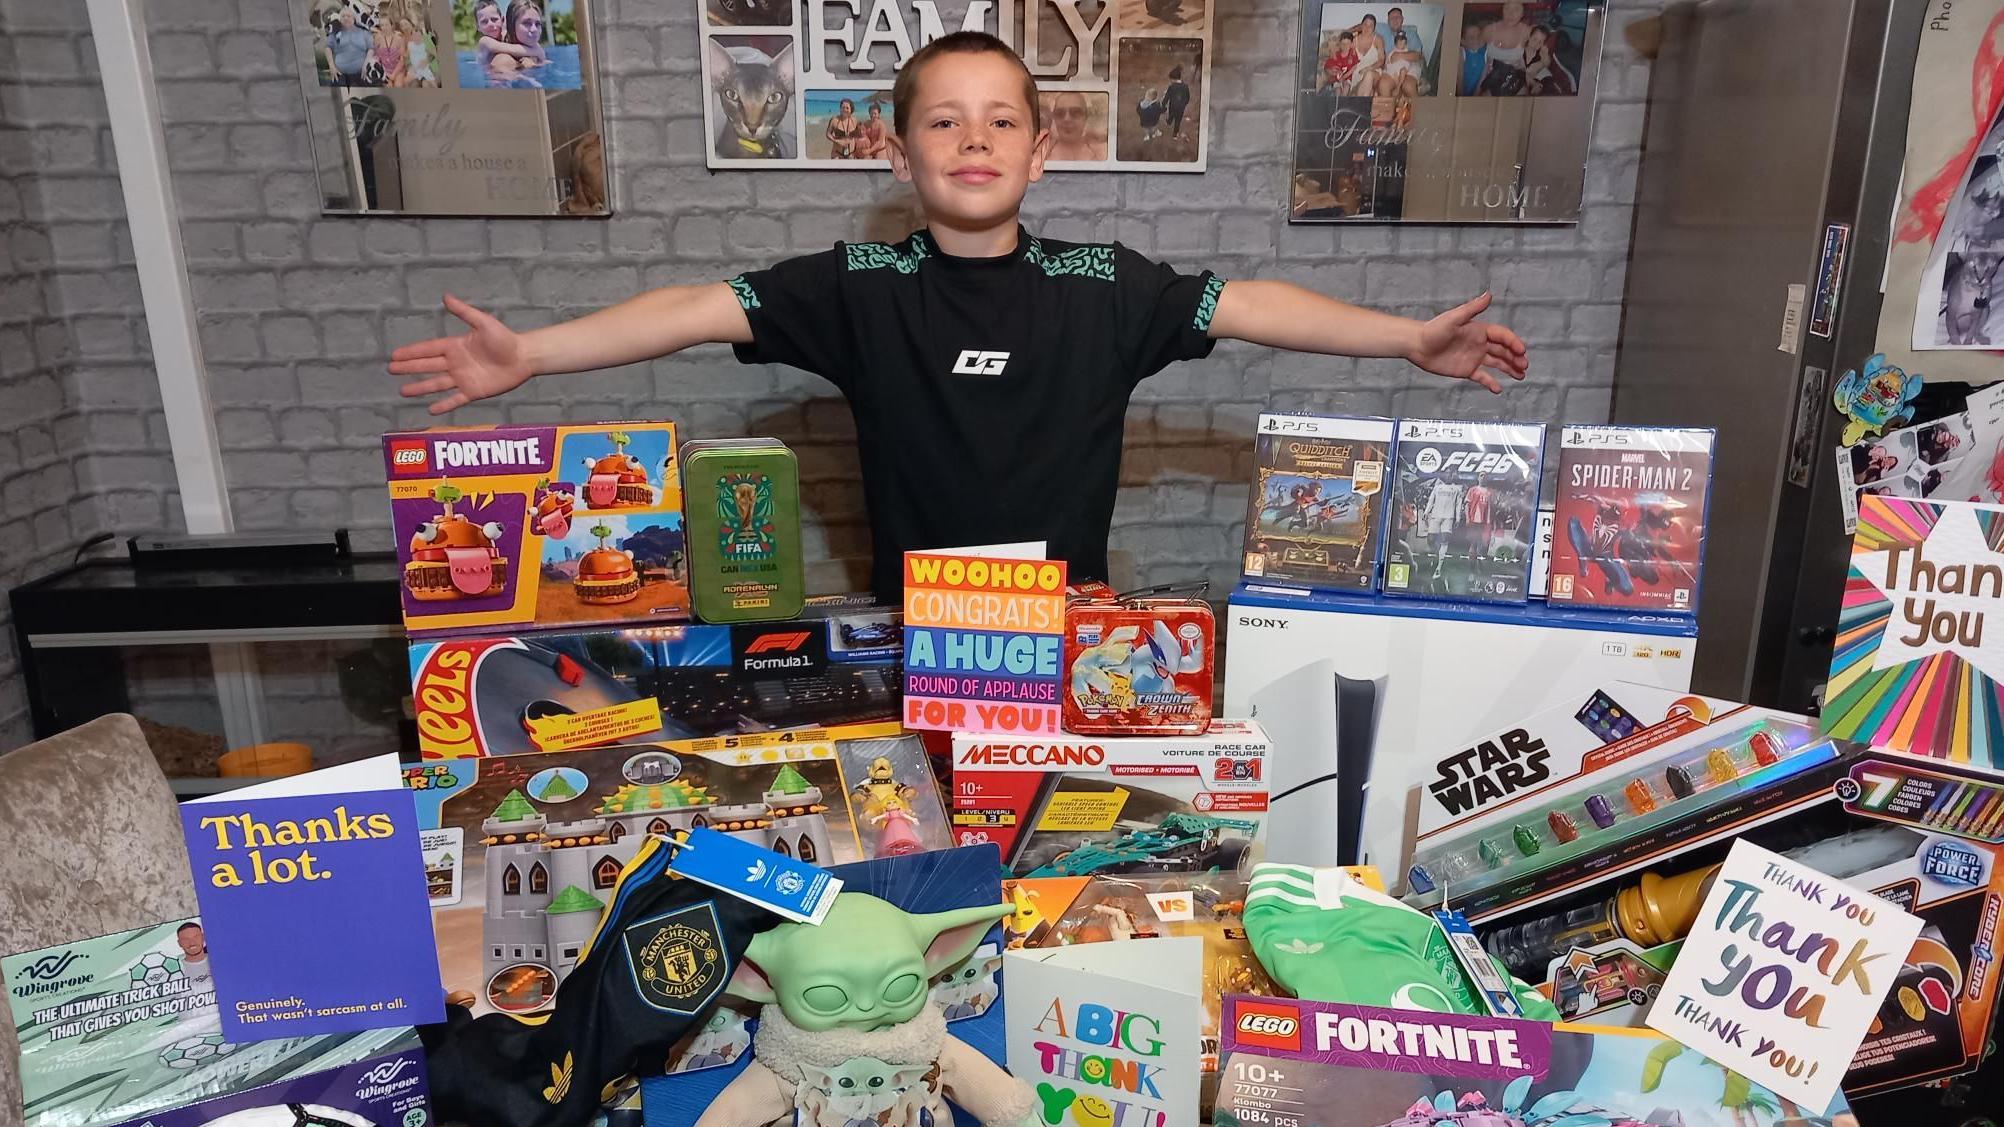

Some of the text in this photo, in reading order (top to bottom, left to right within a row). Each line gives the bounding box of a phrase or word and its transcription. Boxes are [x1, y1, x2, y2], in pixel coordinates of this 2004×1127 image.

[804, 0, 1117, 82] FAMILY
[463, 153, 515, 171] house
[1460, 183, 1549, 208] HOME
[1283, 421, 1319, 432] PS5
[1425, 427, 1463, 438] PS5
[1588, 434, 1628, 445] PS5
[395, 438, 542, 470] LEGO FORTNITE
[1289, 442, 1350, 456] QUIDDITCH
[1421, 453, 1437, 461] EA
[1621, 453, 1645, 463] MARVEL
[1571, 463, 1693, 491] SPIDER-MAN 2
[735, 543, 762, 553] FIFA
[721, 563, 777, 573] CAN USA
[1247, 555, 1262, 570] 12
[909, 557, 1061, 591] WOOHOO
[1395, 567, 1404, 580] 3
[724, 584, 778, 593] ADRENALYN
[1555, 576, 1572, 592] 16
[909, 592, 1060, 628] CONGRATS!
[1239, 616, 1287, 629] SONY
[1900, 596, 1984, 648] you
[909, 630, 1059, 675] A HUGE
[1612, 645, 1622, 653] TB
[1660, 650, 1680, 658] HDR
[909, 676, 1056, 700] ROUND OF APPLAUSE
[1136, 694, 1181, 706] CROWN
[908, 700, 1057, 733] FOR YOU!
[1147, 704, 1192, 716] ZENITH
[724, 738, 739, 748] 5
[778, 733, 794, 743] 4
[959, 744, 1105, 766] MECCANO
[1429, 728, 1550, 792] STAR
[1214, 758, 1234, 780] 2
[1247, 758, 1262, 781] 1
[960, 782, 983, 795] 10+
[1433, 748, 1551, 817] WARS
[1862, 772, 1900, 808] 7
[1902, 785, 1936, 797] COULEURS
[1907, 779, 1932, 789] COLORS
[1892, 798, 1921, 808] COLORES
[1897, 791, 1923, 801] FARBEN
[1888, 804, 1908, 813] CORES
[989, 814, 997, 823] 3
[200, 806, 395, 850] Thanks
[1933, 847, 1977, 865] POWER
[211, 850, 332, 888] a lot.
[1925, 856, 1980, 884] FORCE
[1763, 861, 1828, 904] THANK
[1157, 899, 1188, 913] VS
[1981, 897, 2000, 951] KYBER
[646, 929, 706, 962] MANCHESTER
[1714, 878, 1888, 996] Thank
[12, 974, 94, 997] Wingrove
[665, 974, 706, 994] UNITED
[1970, 957, 1986, 997] CORE
[33, 978, 191, 1025] THE ULTIMATE TRICK BALL
[236, 995, 306, 1013] Genuinely.
[50, 1023, 83, 1041] THAT
[84, 1014, 122, 1033] GIVES
[123, 1007, 151, 1024] YOU
[152, 998, 188, 1018] SHOT
[238, 998, 407, 1025] That wasn't sarcasm at all.
[1032, 997, 1167, 1057] A BIG
[1674, 994, 1750, 1048] THANK
[1239, 1012, 1524, 1069] LEGO FORTNITE
[1234, 1062, 1284, 1083] 10+
[355, 1076, 419, 1099] Wingrove
[1234, 1083, 1278, 1098] 77077
[393, 1100, 426, 1113] and Girls
[1234, 1096, 1271, 1109] Klombo
[406, 1112, 422, 1121] AGE
[1234, 1108, 1298, 1127] 1084 pcs
